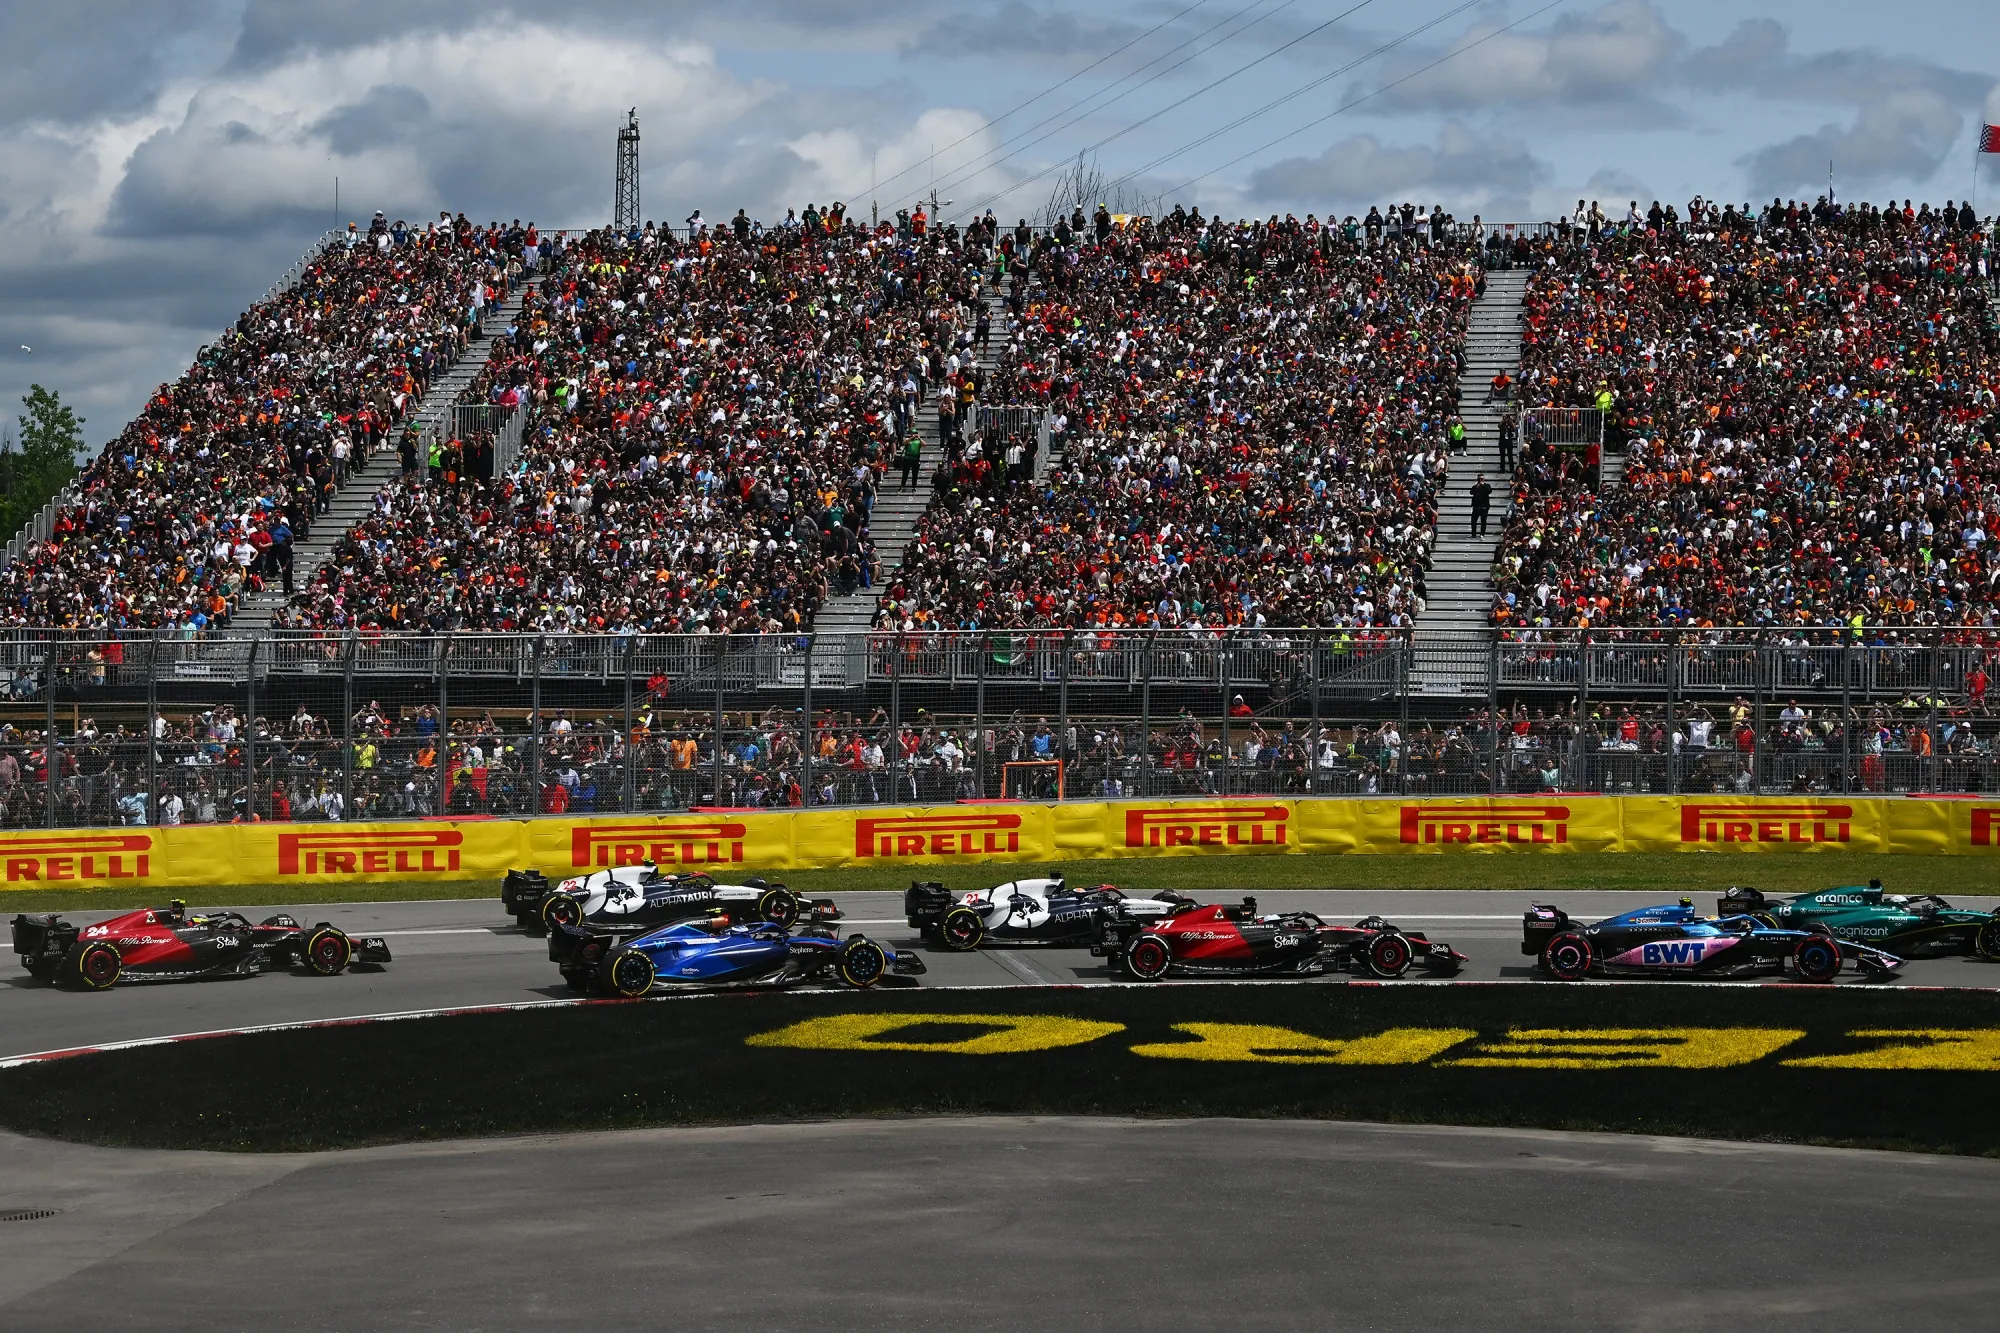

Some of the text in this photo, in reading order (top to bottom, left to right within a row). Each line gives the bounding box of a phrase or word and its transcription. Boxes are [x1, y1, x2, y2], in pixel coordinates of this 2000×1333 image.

[1126, 807, 1289, 848] PIRELLI
[1400, 806, 1568, 843] PIRELLI
[1681, 805, 1852, 843] PIRELLI
[855, 814, 1022, 857] PIRELLI
[572, 824, 746, 867] PIRELLI
[278, 830, 463, 875] PIRELLI
[563, 881, 577, 891] 22
[650, 890, 713, 909] ALPHATAURI
[966, 893, 980, 904] 21
[1815, 895, 1864, 904] aramco
[1778, 905, 1792, 917] 18
[87, 925, 109, 938] 24
[1154, 920, 1176, 930] 77
[1834, 925, 1889, 938] cognizant
[118, 935, 173, 948] Alfa Romeo
[216, 936, 240, 949] Stake
[1180, 930, 1235, 942] Alfa Romeo
[1273, 935, 1299, 949] Stake
[366, 938, 384, 949] Stake
[789, 946, 814, 954] Stephens
[1430, 943, 1449, 953] Stake
[1643, 943, 1705, 965] BWT
